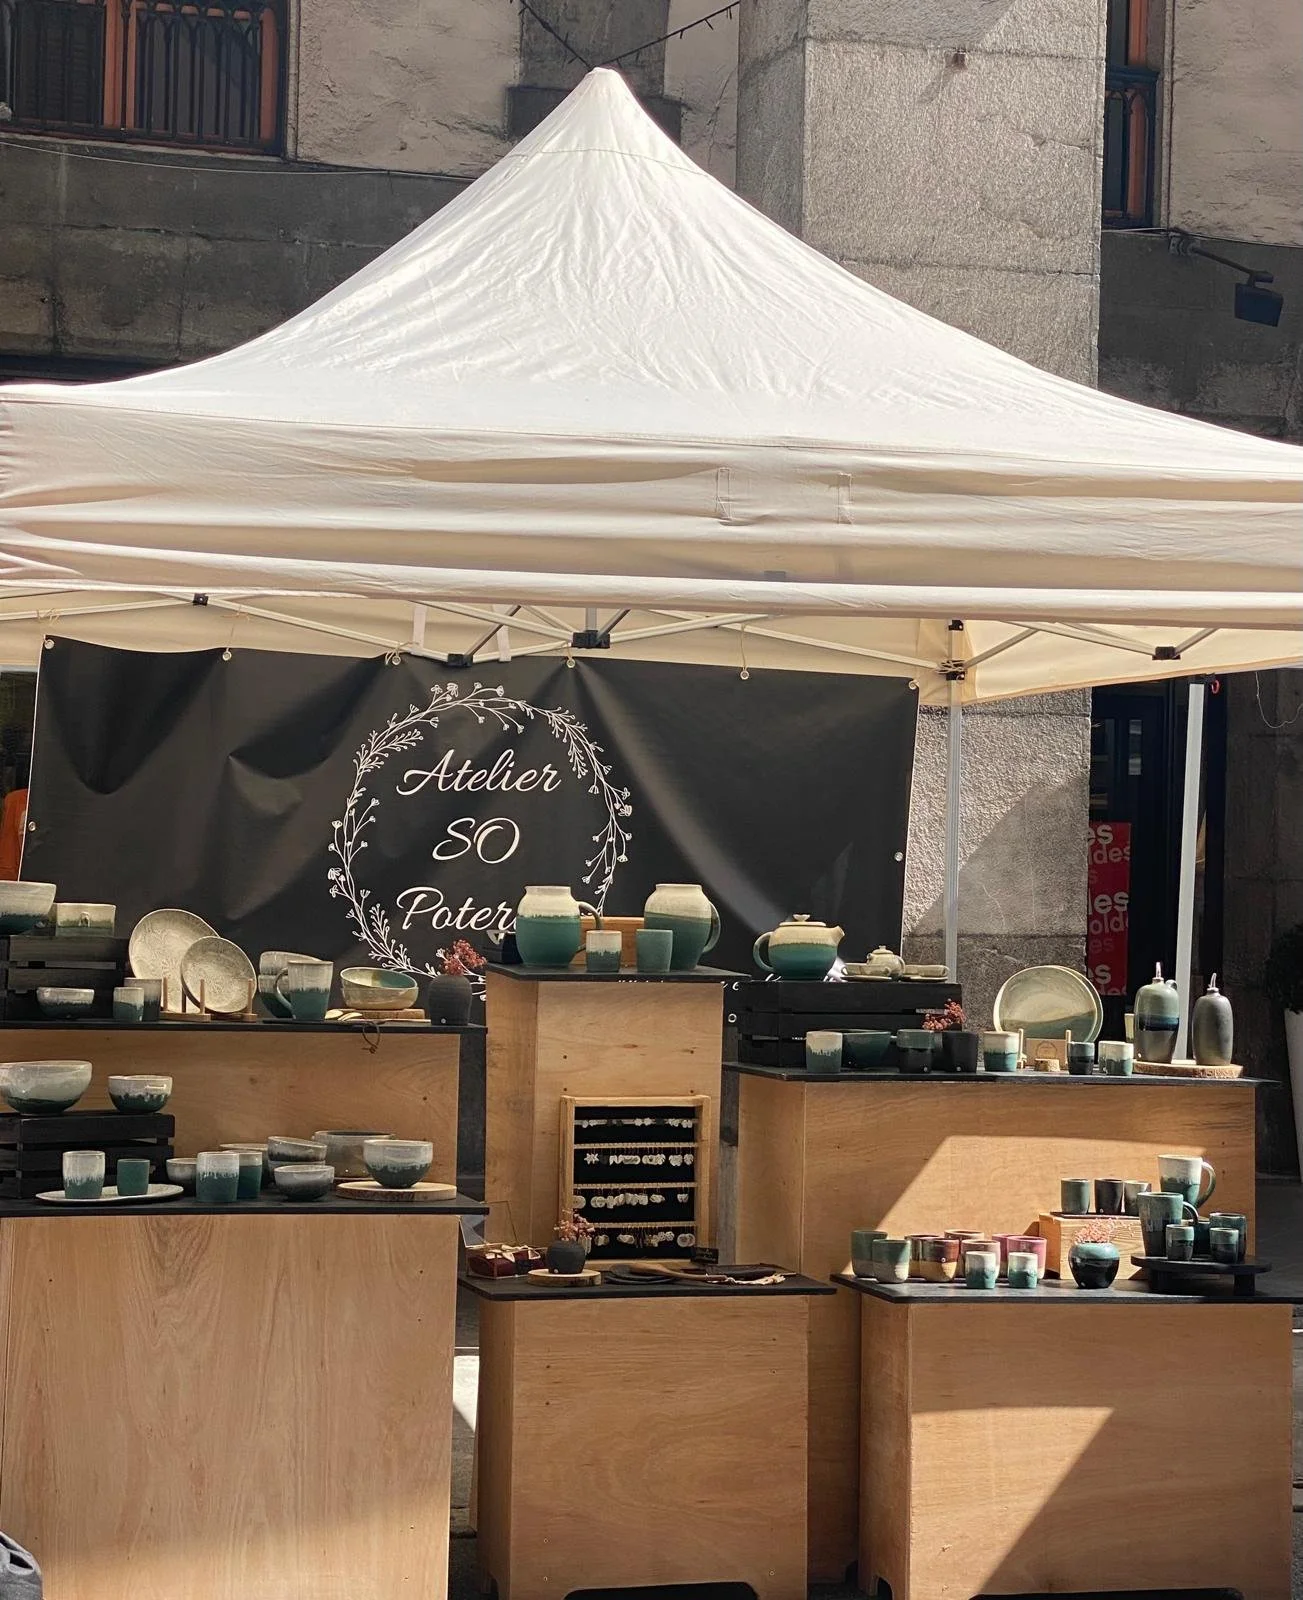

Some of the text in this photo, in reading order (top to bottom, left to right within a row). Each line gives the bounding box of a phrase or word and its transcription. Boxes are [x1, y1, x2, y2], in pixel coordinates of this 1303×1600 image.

[396, 749, 561, 796] Atelier
[432, 817, 520, 864] SO
[1089, 911, 1129, 934] old
